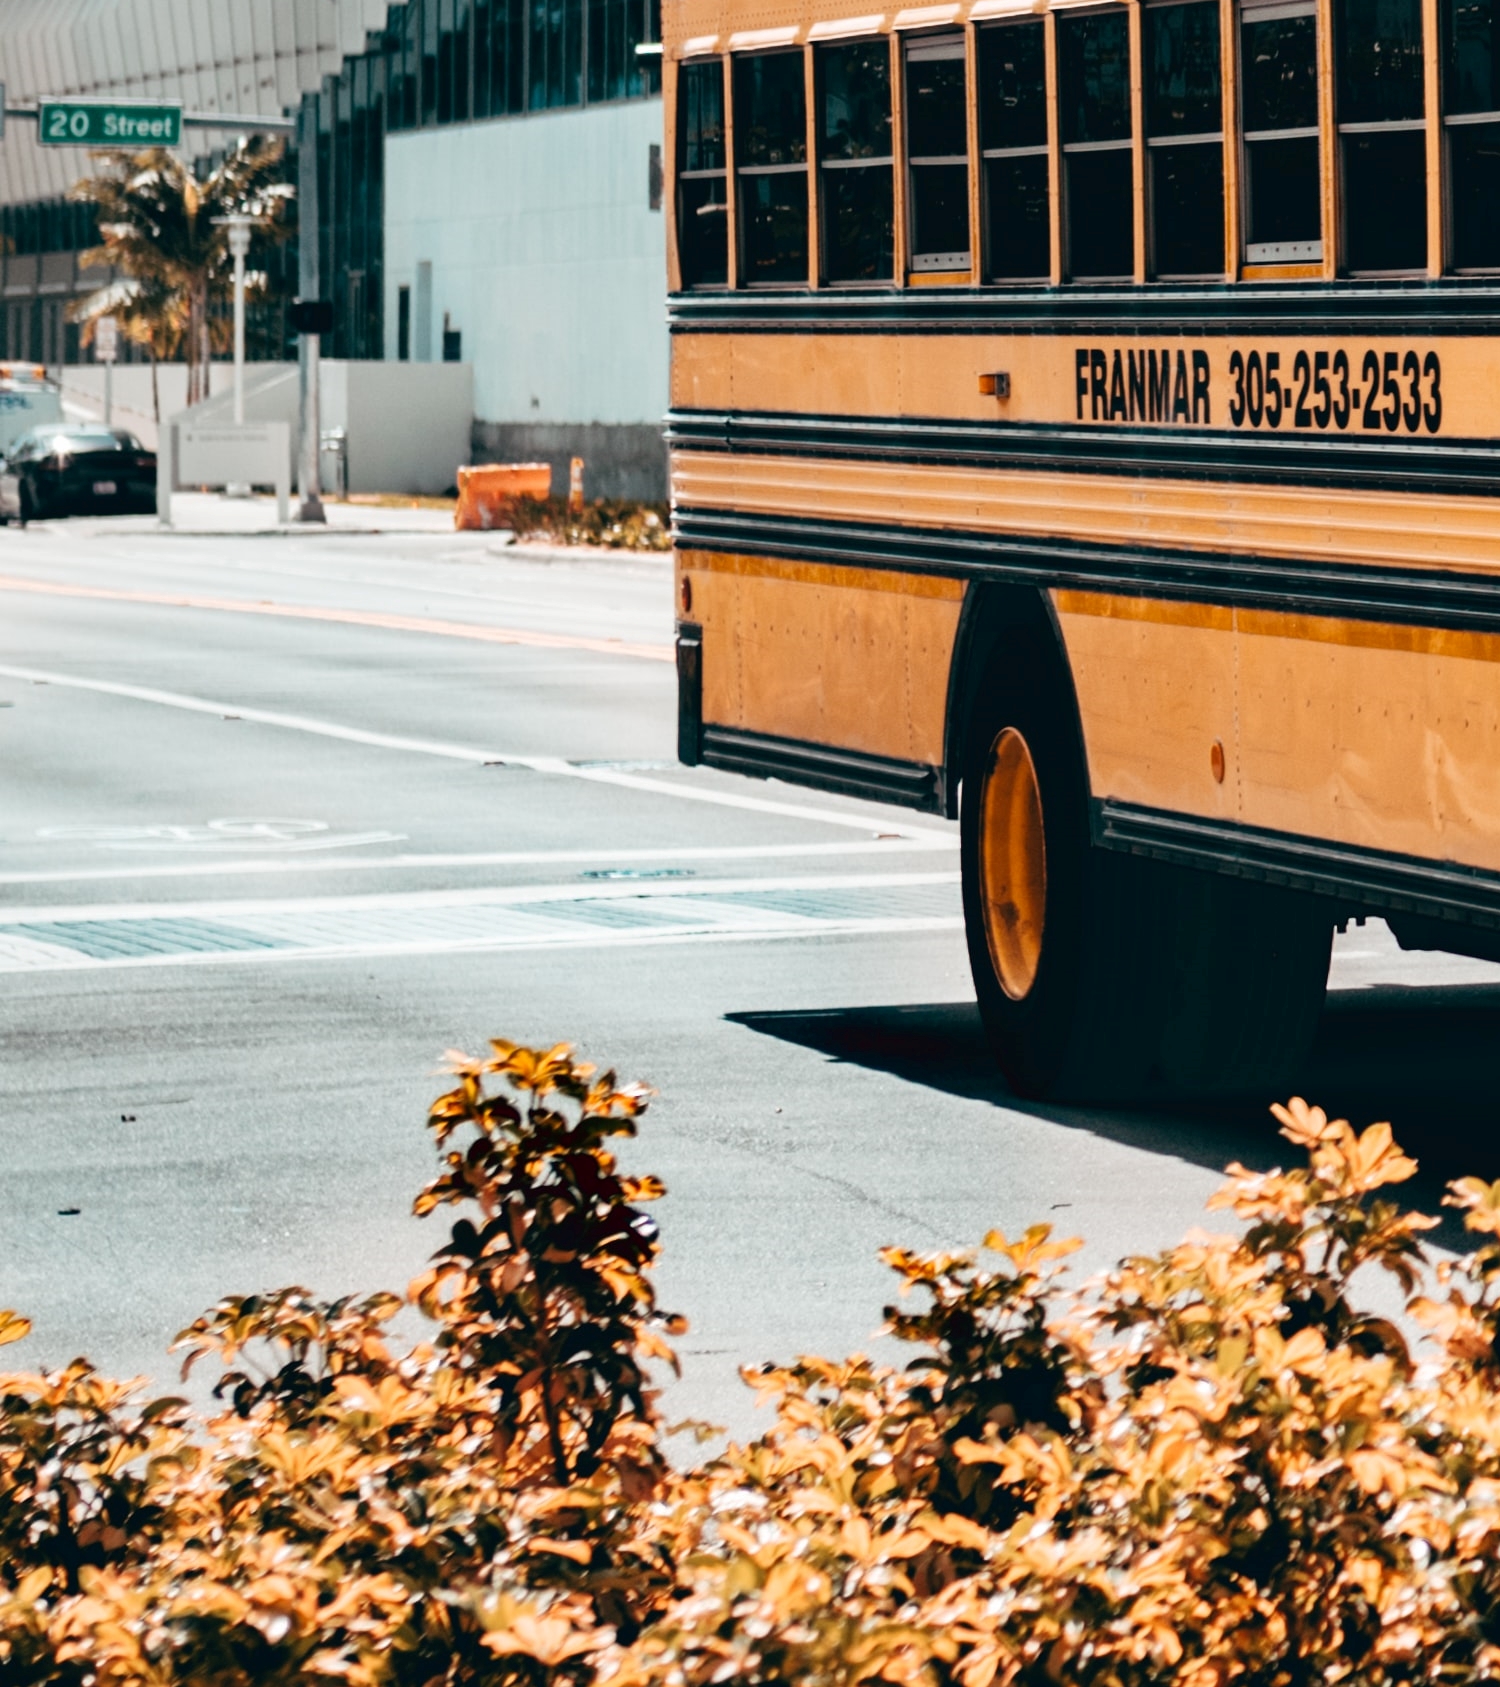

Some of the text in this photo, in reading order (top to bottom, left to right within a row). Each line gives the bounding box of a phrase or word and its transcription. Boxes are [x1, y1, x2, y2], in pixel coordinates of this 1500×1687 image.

[49, 109, 173, 138] 20 Street
[1075, 348, 1441, 433] FRANMAR 305-253-2533
